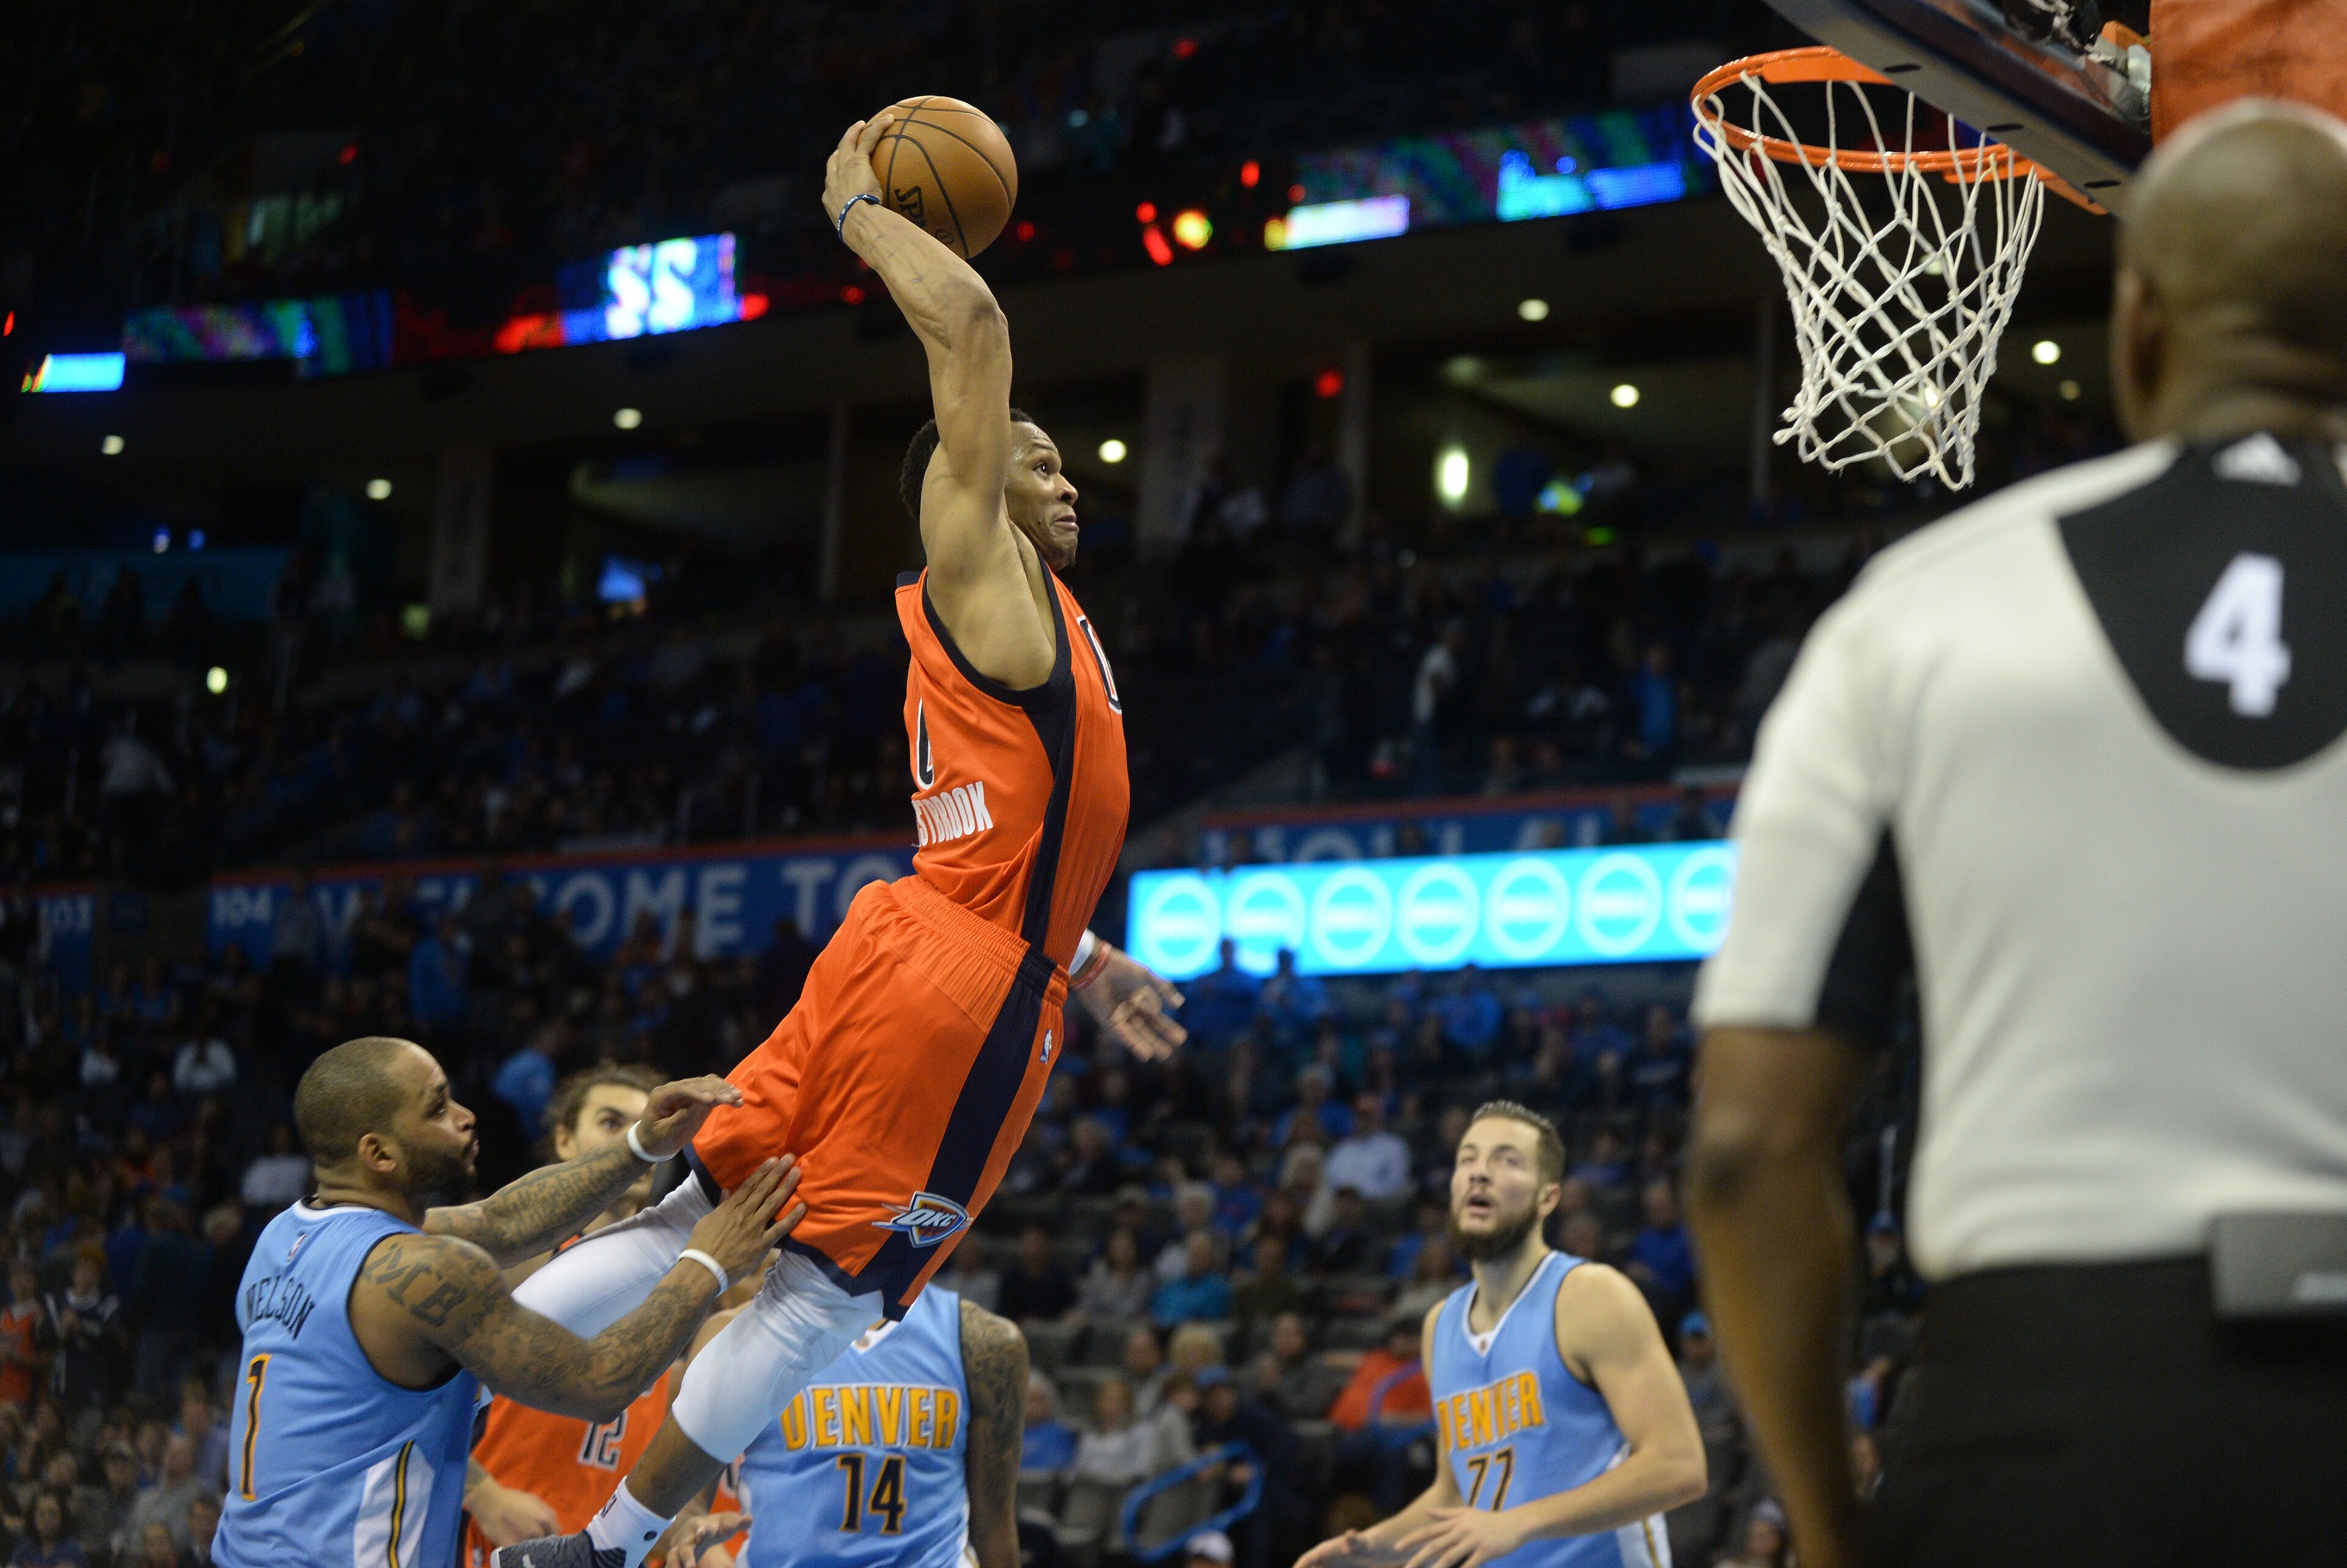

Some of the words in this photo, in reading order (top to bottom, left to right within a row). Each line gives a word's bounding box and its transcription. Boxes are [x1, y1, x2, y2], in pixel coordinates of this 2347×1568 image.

[894, 186, 927, 227] SP
[2182, 551, 2291, 717] 4
[895, 1208, 958, 1227] OKC
[246, 1277, 315, 1341] NELSON
[240, 1353, 272, 1501] 1
[577, 1409, 628, 1473] 12
[779, 1383, 962, 1452] DENVER
[836, 1454, 907, 1536] 14
[1467, 1443, 1515, 1511] 77
